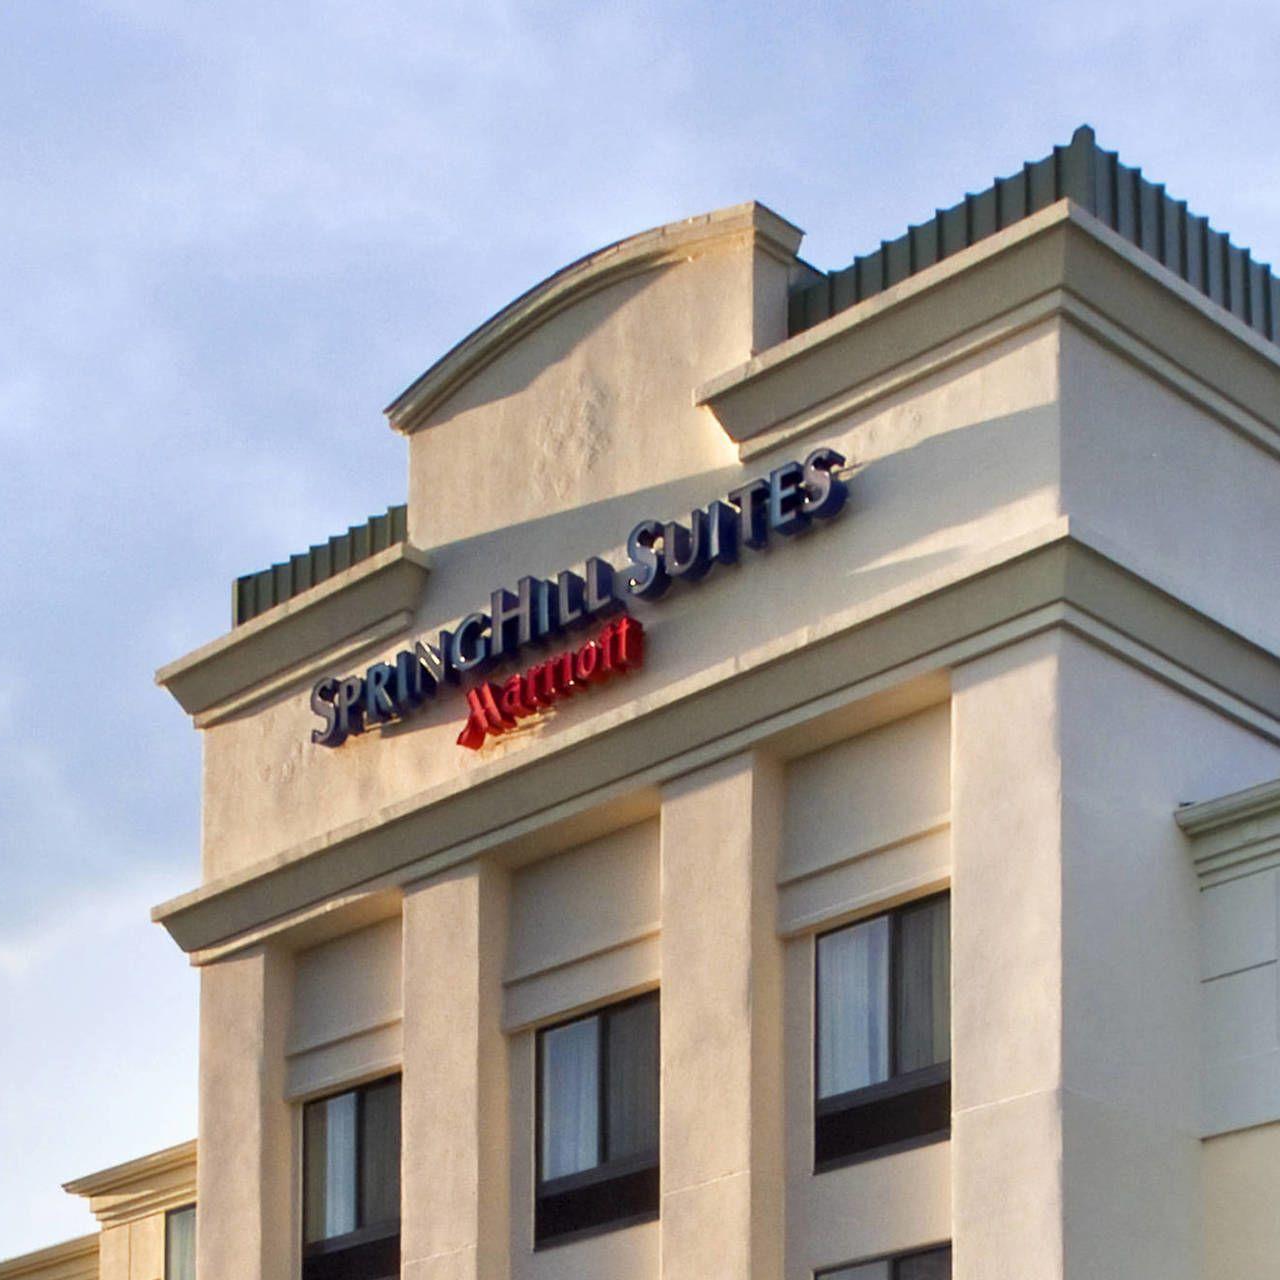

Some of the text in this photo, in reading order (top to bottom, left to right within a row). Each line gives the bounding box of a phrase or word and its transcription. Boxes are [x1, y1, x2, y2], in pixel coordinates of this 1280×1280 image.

[311, 448, 847, 748] SPRINGHILL SUITES
[456, 616, 643, 751] Marriott
